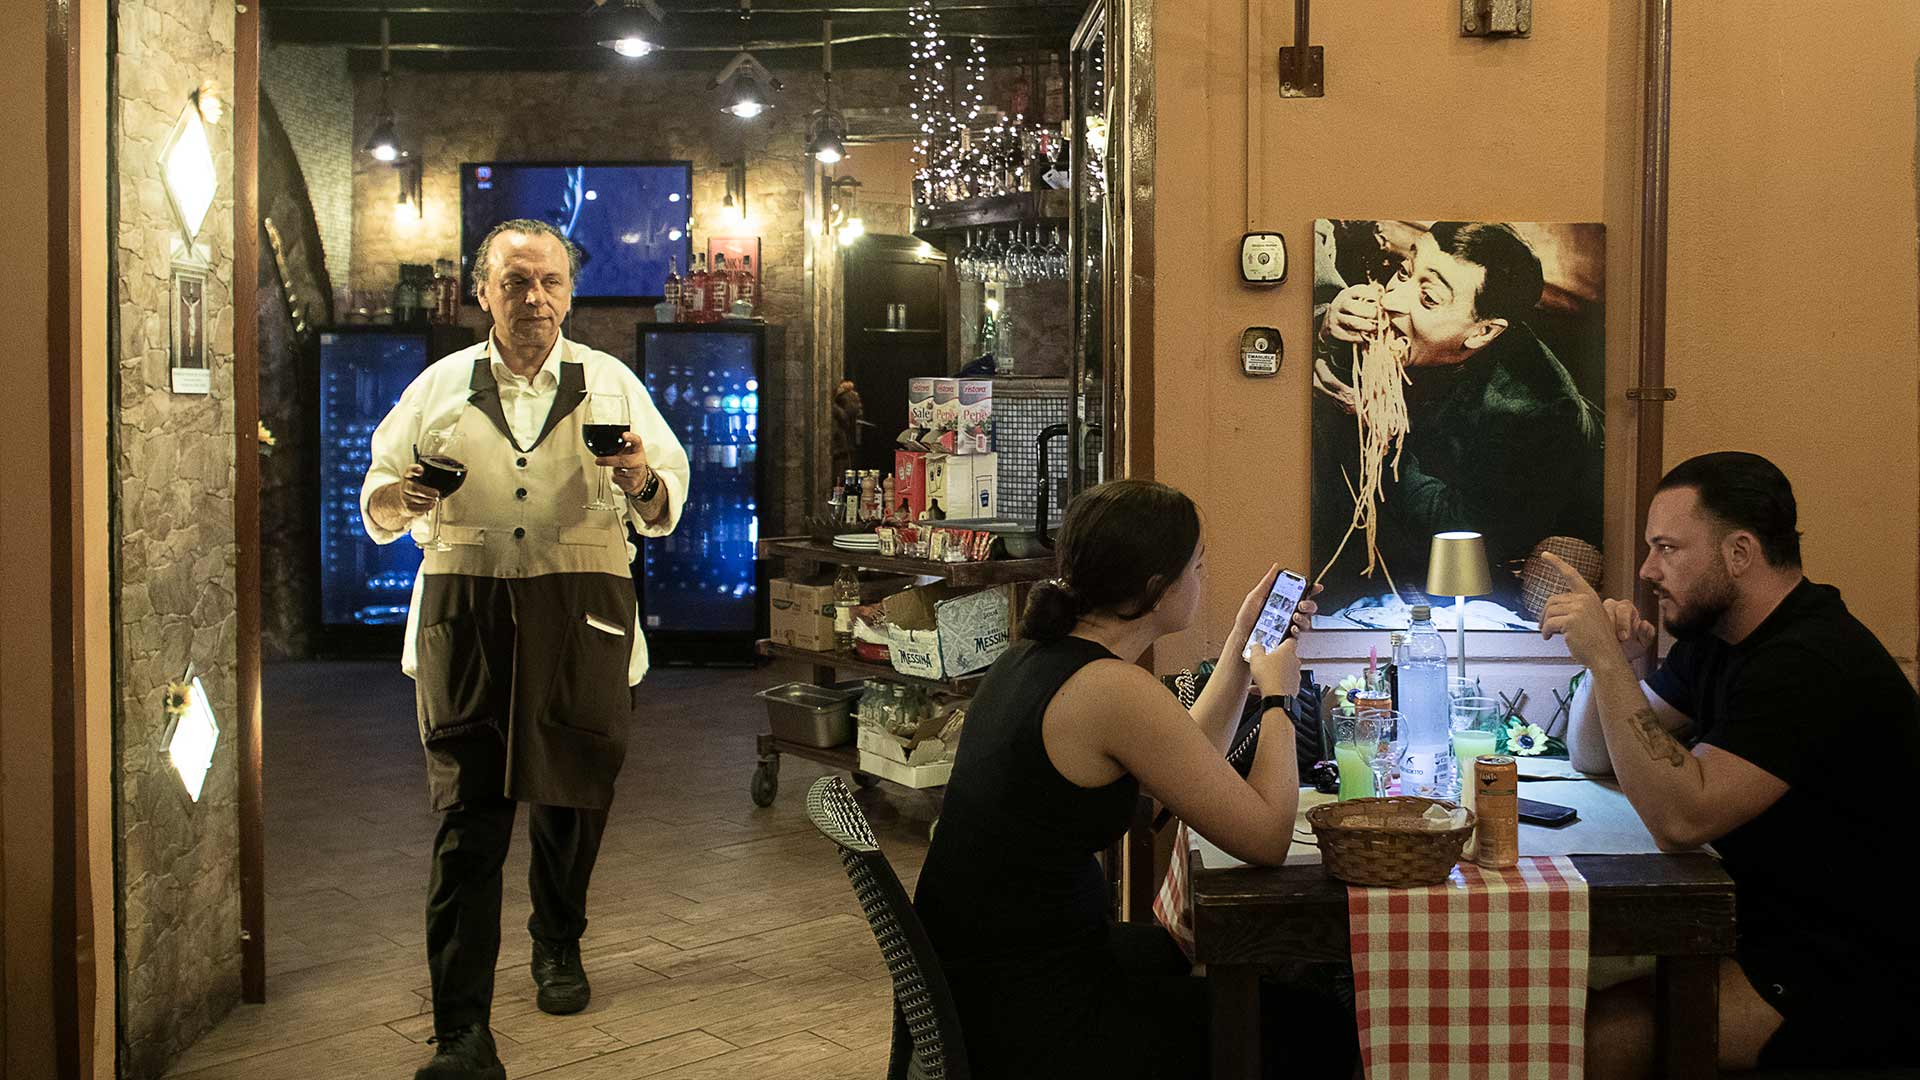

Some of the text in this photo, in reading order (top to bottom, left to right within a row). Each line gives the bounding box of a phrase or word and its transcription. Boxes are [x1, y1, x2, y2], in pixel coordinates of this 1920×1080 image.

[964, 384, 987, 394] ristora
[912, 407, 930, 419] Sale
[963, 410, 987, 423] Pepe
[898, 649, 932, 668] MESSINA
